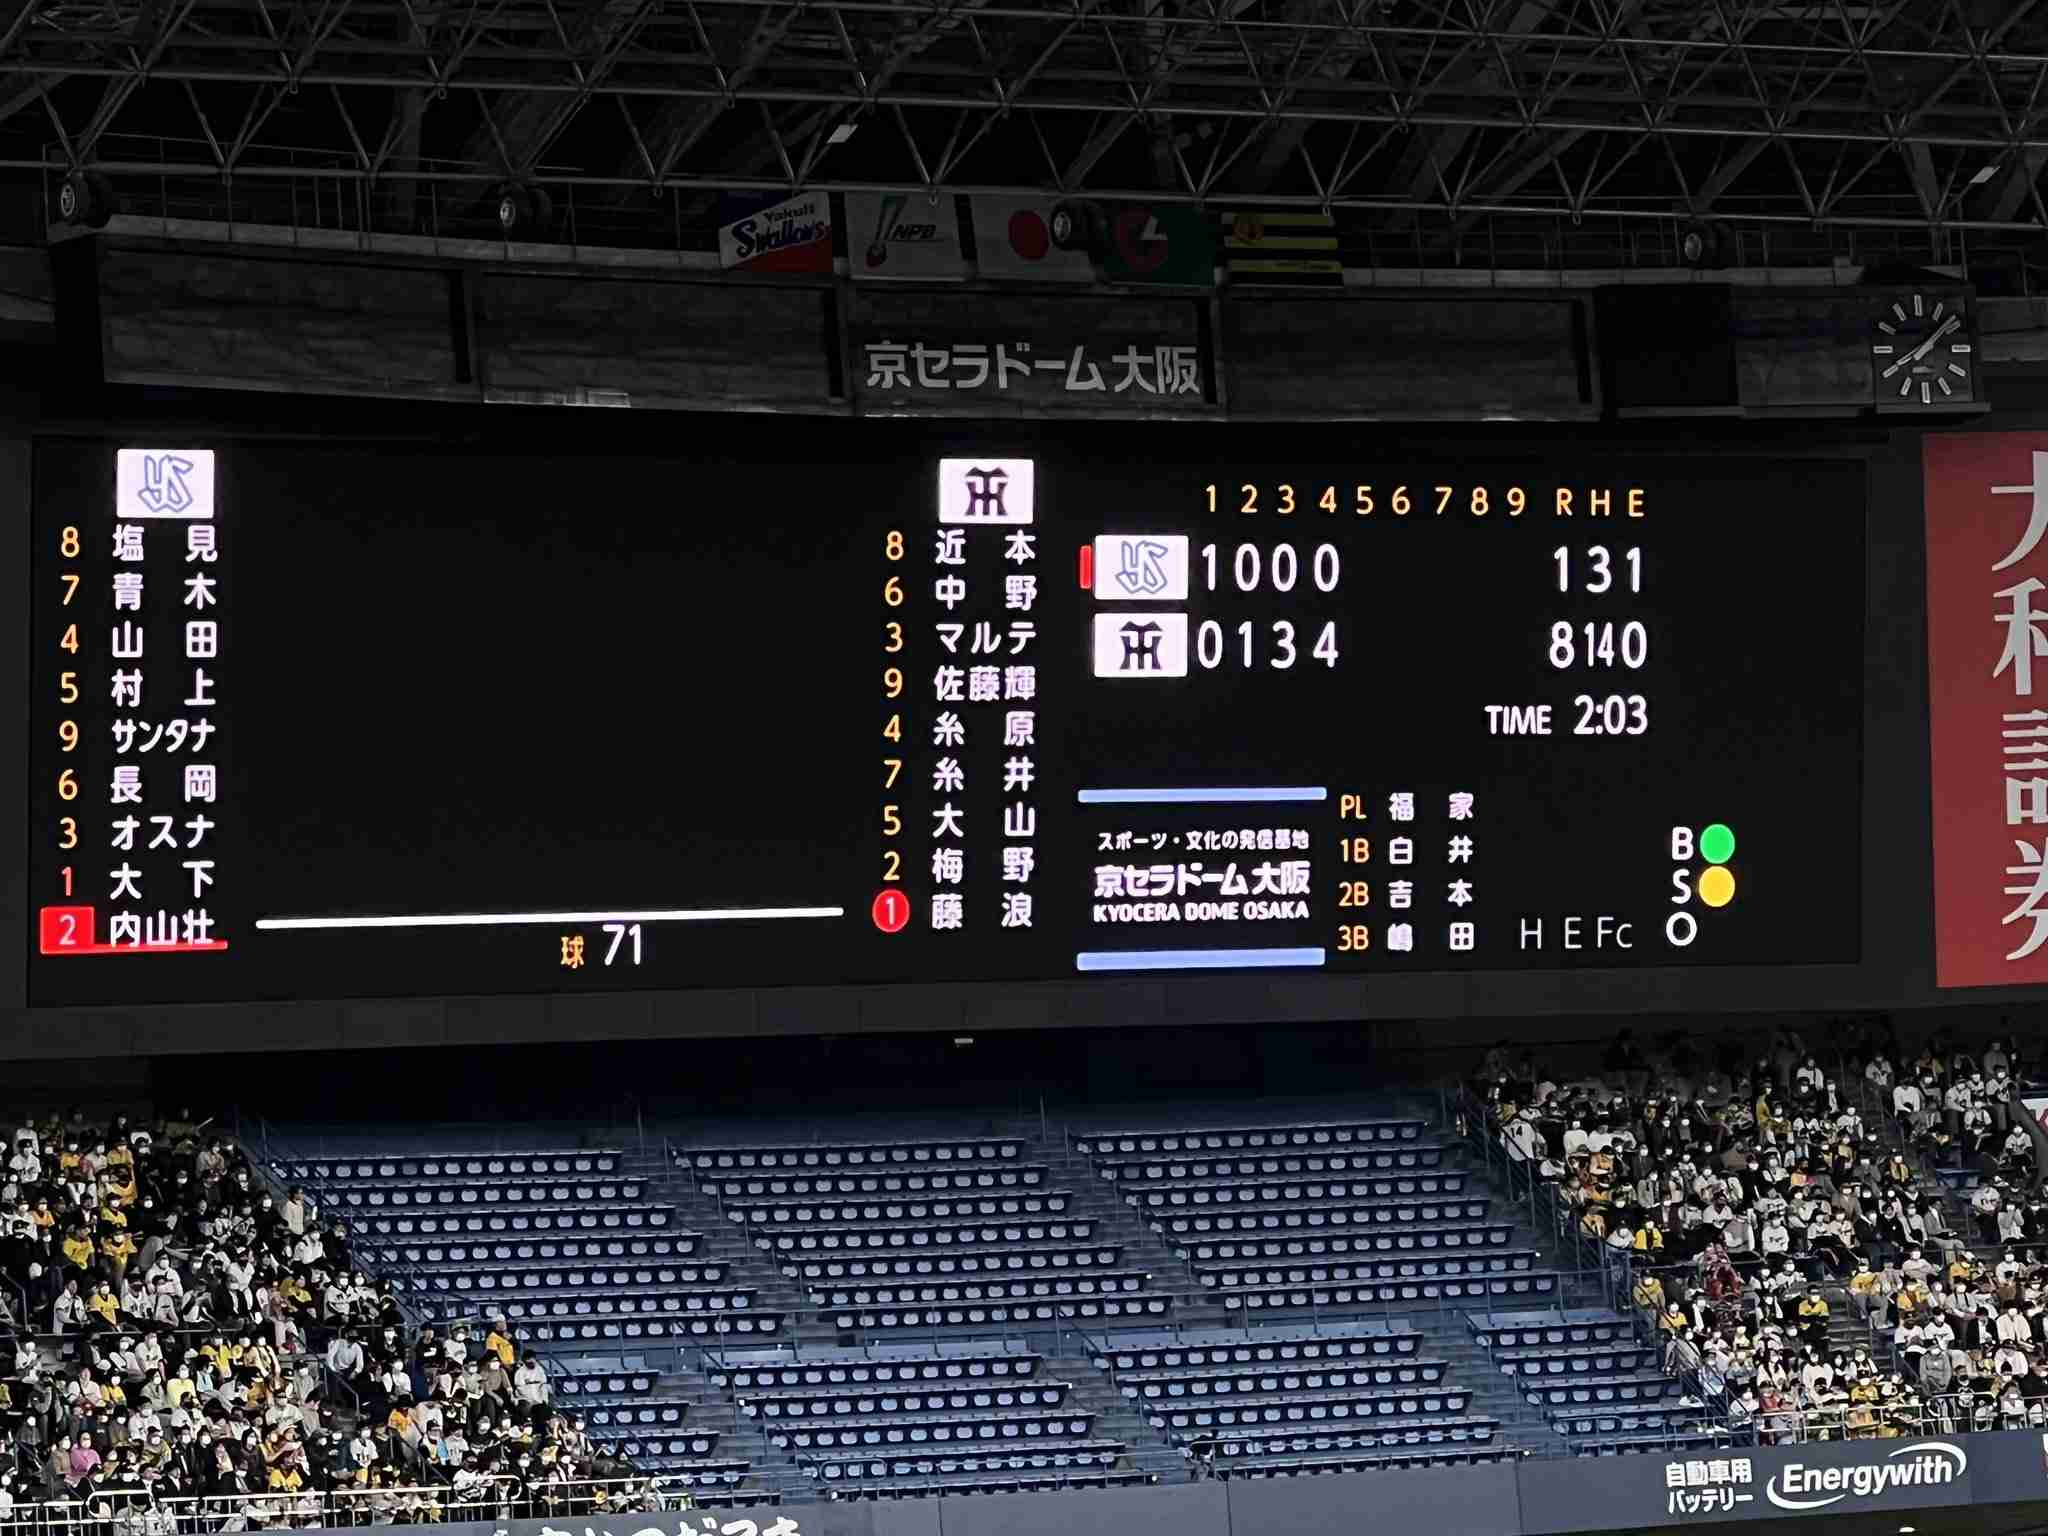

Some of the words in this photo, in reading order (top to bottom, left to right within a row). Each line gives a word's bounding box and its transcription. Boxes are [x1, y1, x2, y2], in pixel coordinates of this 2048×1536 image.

[1207, 485, 1215, 512] 1
[1241, 485, 1257, 513] 2
[1278, 485, 1294, 513] 3
[1320, 486, 1336, 512] 4
[1357, 486, 1373, 514] 5
[1392, 486, 1410, 514] 6
[1436, 487, 1452, 514] 7
[1471, 487, 1488, 515] 8
[1507, 488, 1524, 515] 9
[1557, 488, 1572, 515] R
[1591, 490, 1609, 515] H
[1629, 490, 1644, 517] E
[61, 527, 79, 557] 8
[886, 531, 903, 560] 8
[1202, 544, 1215, 590] 1
[1235, 544, 1260, 591] 0
[1272, 544, 1297, 592] 0
[1314, 544, 1339, 592] 0
[1554, 547, 1567, 592] 1
[1587, 546, 1611, 592] 3
[1627, 547, 1640, 592] 1
[62, 575, 79, 605] 7
[885, 577, 903, 606] 6
[61, 624, 78, 653] 4
[886, 623, 902, 652] 3
[936, 622, 1036, 654] マルテ
[1198, 620, 1222, 668] 0
[1239, 621, 1251, 667] 1
[1271, 621, 1296, 668] 3
[1313, 622, 1338, 667] 4
[1550, 621, 1574, 668] 8
[1584, 622, 1614, 666] 14
[1622, 621, 1647, 668] 0
[61, 672, 78, 703] 5
[885, 668, 902, 697] 9
[934, 665, 1035, 701] 佐藤輝
[884, 715, 901, 742] 4
[1485, 705, 1551, 734] TIME
[1574, 695, 1647, 734] 2:03
[60, 721, 78, 751] 9
[112, 718, 215, 753] サンタナ
[59, 769, 77, 800] 6
[884, 760, 901, 788] 7
[884, 806, 900, 835] 5
[1341, 795, 1366, 819] PL
[60, 817, 77, 848] 3
[112, 814, 214, 850] オスナ
[1099, 829, 1308, 850] スポーツ・文化の発信基地
[1672, 827, 1693, 860] B
[884, 851, 899, 880] 2
[1341, 838, 1369, 863] 1B
[62, 867, 71, 896] 1
[1339, 882, 1369, 906] 2B
[1672, 869, 1691, 904] S
[884, 898, 896, 925] 1
[1093, 903, 1181, 923] KYOCERA
[1184, 902, 1239, 921] DOME
[1243, 900, 1310, 920] OSAKA
[59, 914, 76, 945] 2
[111, 909, 215, 948] 内山壮
[1338, 925, 1368, 950] 3B
[1521, 919, 1541, 949] H
[1565, 917, 1581, 948] E
[1598, 917, 1632, 947] Fc
[1666, 912, 1697, 946] O
[560, 935, 585, 969] 球
[601, 923, 641, 966] 71
[1666, 1458, 1752, 1488] 自動車用
[1783, 1455, 1953, 1496] Energywith
[1668, 1487, 1753, 1514] バッテリー
